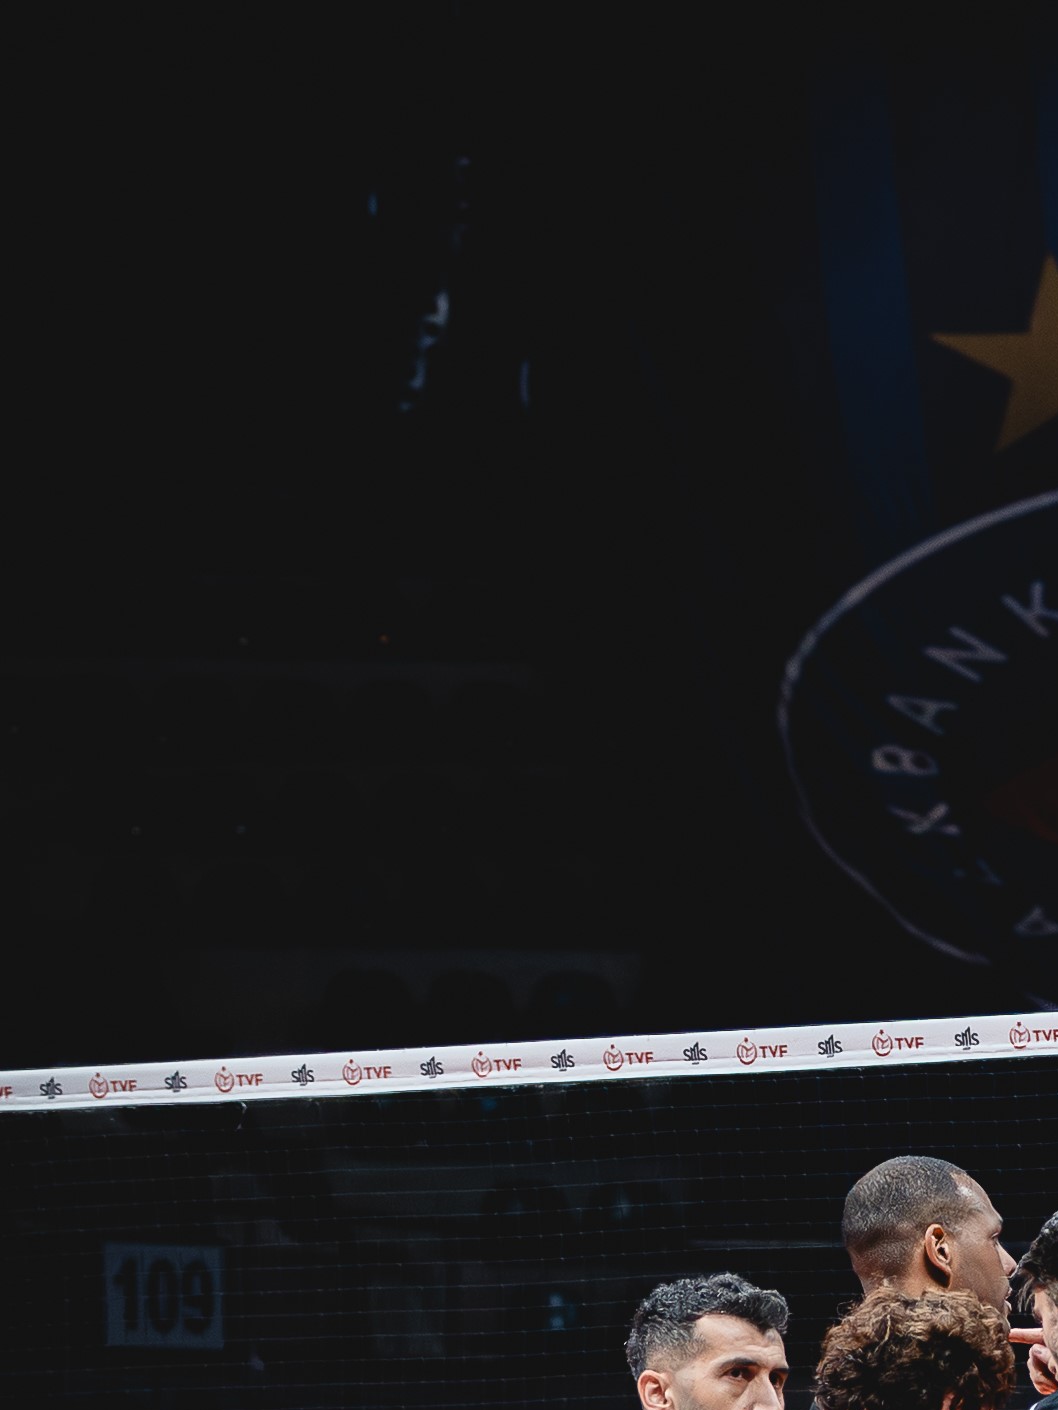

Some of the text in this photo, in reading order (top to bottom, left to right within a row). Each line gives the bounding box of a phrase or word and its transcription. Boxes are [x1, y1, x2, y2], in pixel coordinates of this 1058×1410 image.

[110, 1080, 137, 1092] TVF
[235, 1073, 263, 1086] TVF
[364, 1066, 392, 1079] TVF
[493, 1058, 523, 1071] TVF
[625, 1051, 654, 1064] TVF
[759, 1044, 787, 1057] TVF
[894, 1036, 925, 1049] TVF
[112, 1255, 214, 1335] 109
